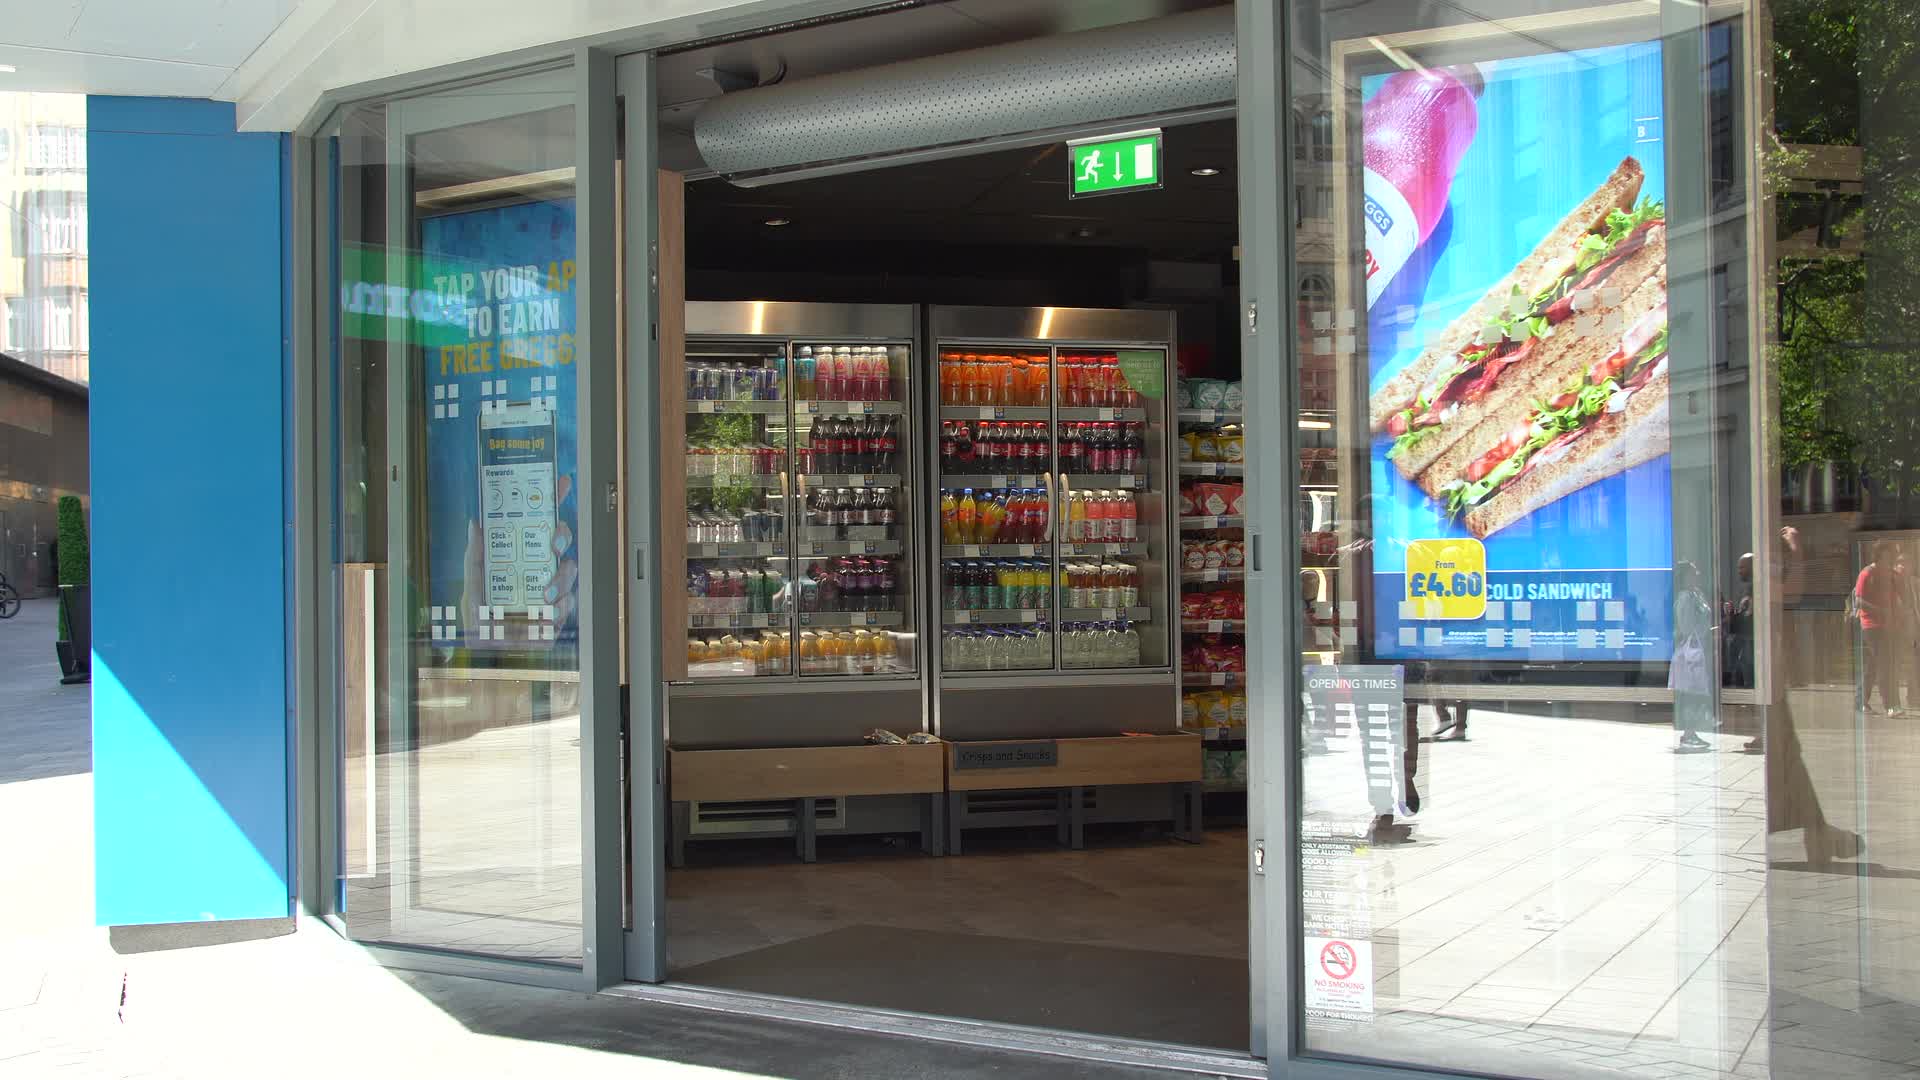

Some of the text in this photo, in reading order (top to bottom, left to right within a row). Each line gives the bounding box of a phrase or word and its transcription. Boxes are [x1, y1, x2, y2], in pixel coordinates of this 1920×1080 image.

[1637, 126, 1646, 138] B
[1364, 198, 1390, 230] GGS
[434, 272, 475, 306] TAP
[481, 265, 540, 303] YOUR
[465, 305, 492, 338] TO
[500, 298, 560, 335] EARN
[440, 332, 577, 376] FREE GREGG
[485, 469, 514, 477] Rewards
[491, 532, 506, 540] Click
[491, 541, 513, 549] Collect
[1435, 560, 1455, 569] From
[498, 584, 514, 592] shop
[1409, 571, 1483, 597] £4.60
[1527, 582, 1612, 599] SANDWICH
[1309, 678, 1397, 689] OPENING TIMES
[961, 749, 1050, 765] Crisps and Snacks
[1314, 979, 1366, 991] NO SMOKING
